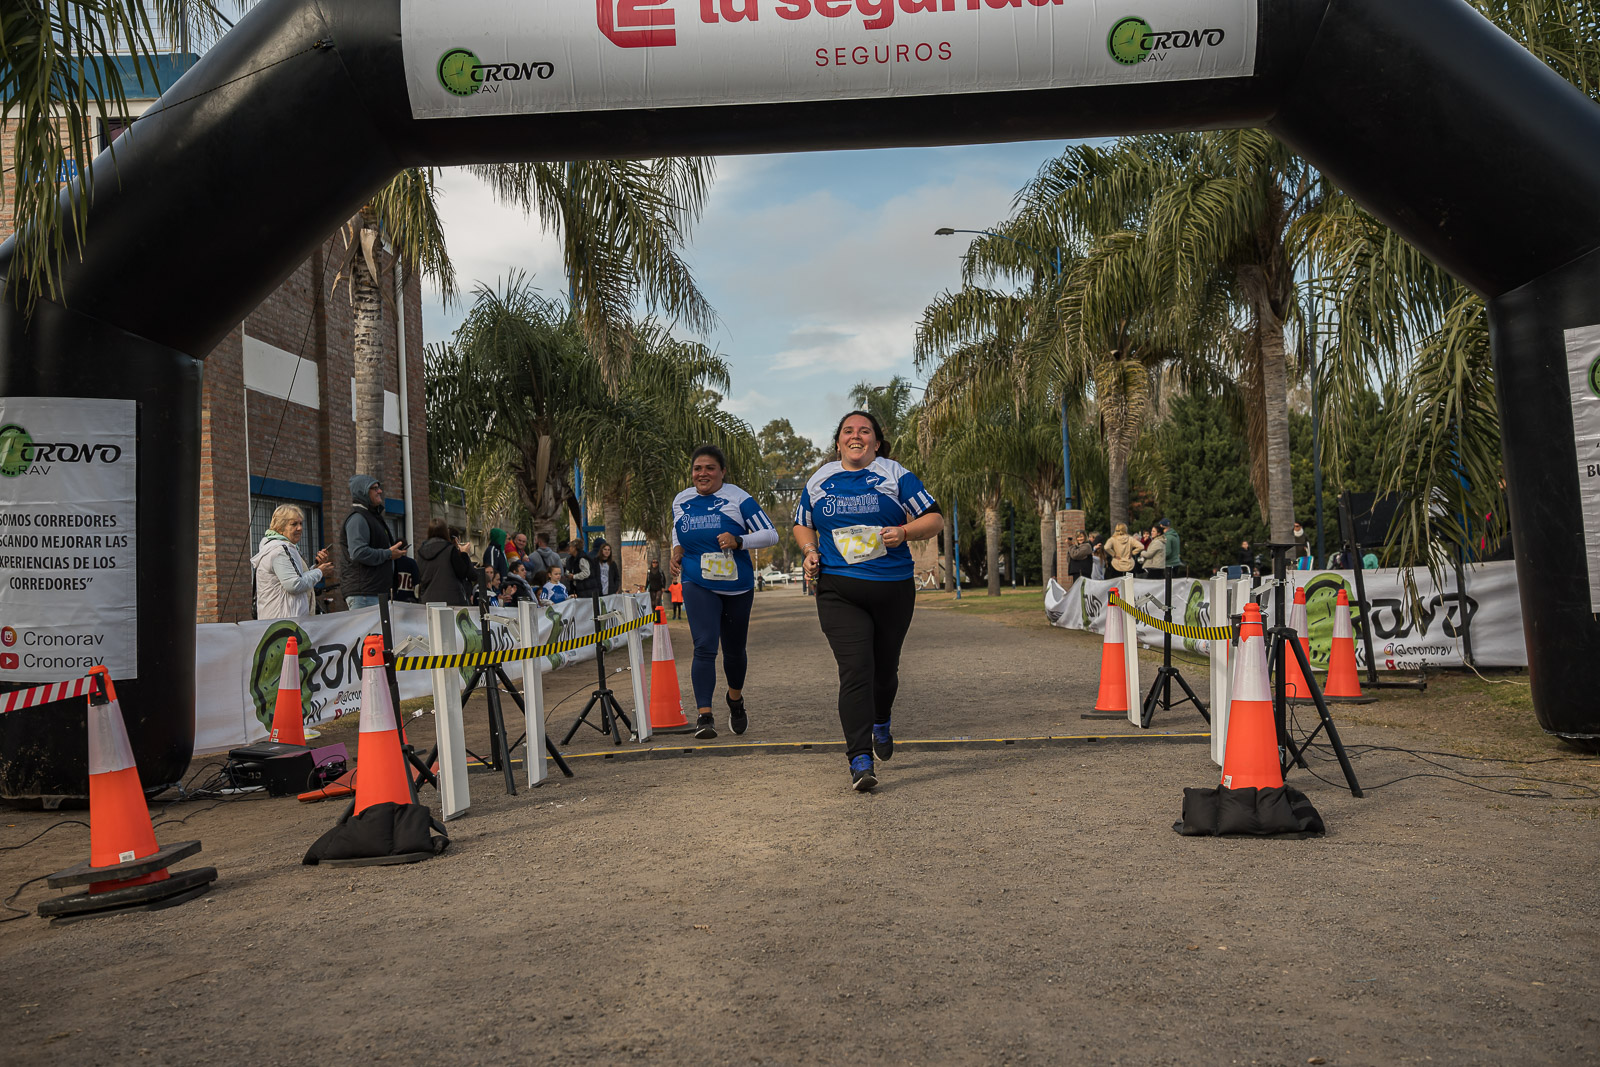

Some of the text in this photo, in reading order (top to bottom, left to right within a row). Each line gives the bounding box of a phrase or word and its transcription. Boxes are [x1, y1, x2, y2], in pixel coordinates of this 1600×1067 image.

[1140, 28, 1225, 51] CRONO
[815, 41, 952, 67] SEGUROS
[1137, 52, 1168, 63] RAV
[470, 61, 555, 82] CRONO
[470, 84, 500, 94] RAV
[20, 443, 122, 464] CRONO
[18, 465, 52, 475] RAV
[822, 494, 836, 517] 3
[34, 514, 117, 527] CORREDORES
[681, 513, 691, 533] 3
[41, 535, 102, 549] MEJORAR
[105, 535, 128, 548] LAS
[838, 533, 881, 557] 734
[73, 557, 90, 569] DE
[93, 556, 116, 569] LOS
[705, 559, 735, 575] 719
[23, 631, 104, 646] Cronorav
[1395, 644, 1452, 658] @cronorav
[23, 653, 104, 668] Cronorav
